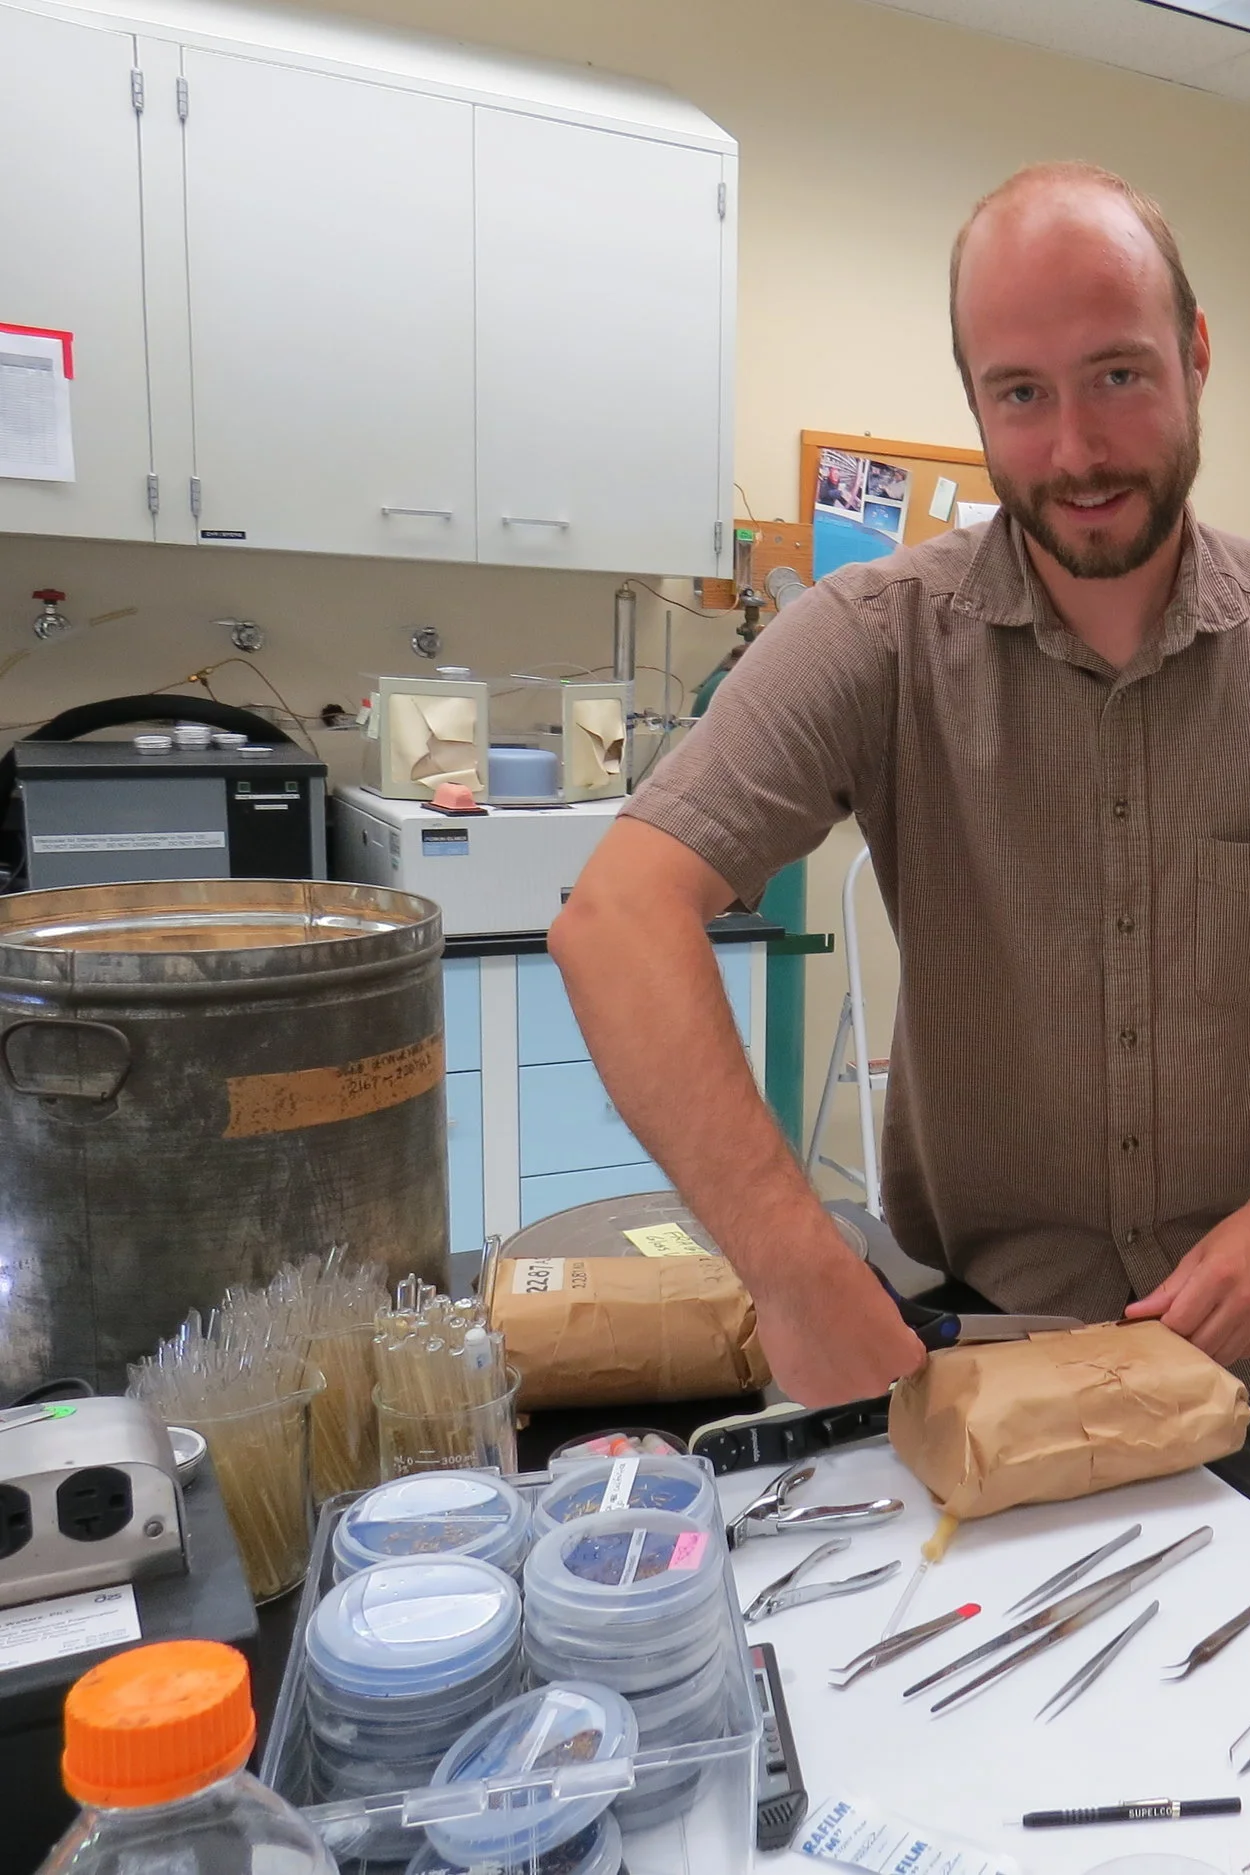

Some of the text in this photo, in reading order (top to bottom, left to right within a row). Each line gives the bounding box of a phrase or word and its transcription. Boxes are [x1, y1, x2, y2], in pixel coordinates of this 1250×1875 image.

[441, 1455, 462, 1466] 300
[1128, 1805, 1172, 1820] SUPELCO
[802, 1801, 851, 1857] RAFILM
[890, 1839, 928, 1875] FILM
